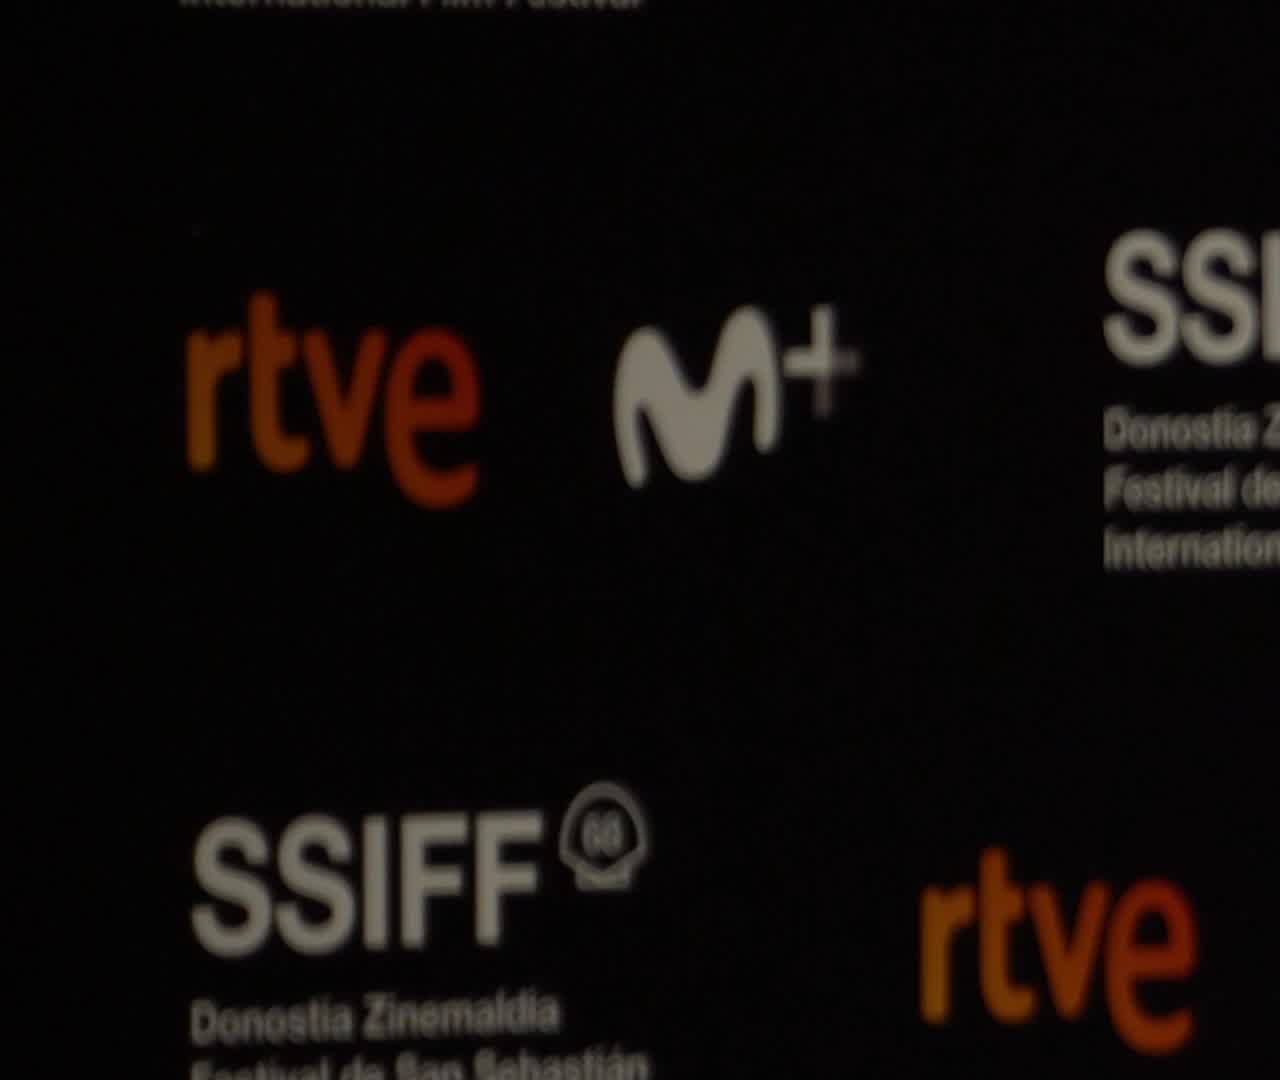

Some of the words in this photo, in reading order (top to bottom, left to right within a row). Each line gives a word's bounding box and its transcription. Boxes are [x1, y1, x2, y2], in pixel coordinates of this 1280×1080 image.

[186, 292, 481, 509] rtve
[1104, 403, 1258, 452] Donostia
[1104, 462, 1238, 511] Festival
[191, 809, 544, 958] SSIFF
[919, 847, 1198, 1056] rtve
[191, 996, 354, 1045] Donostia
[362, 987, 562, 1040] Zinemaldia
